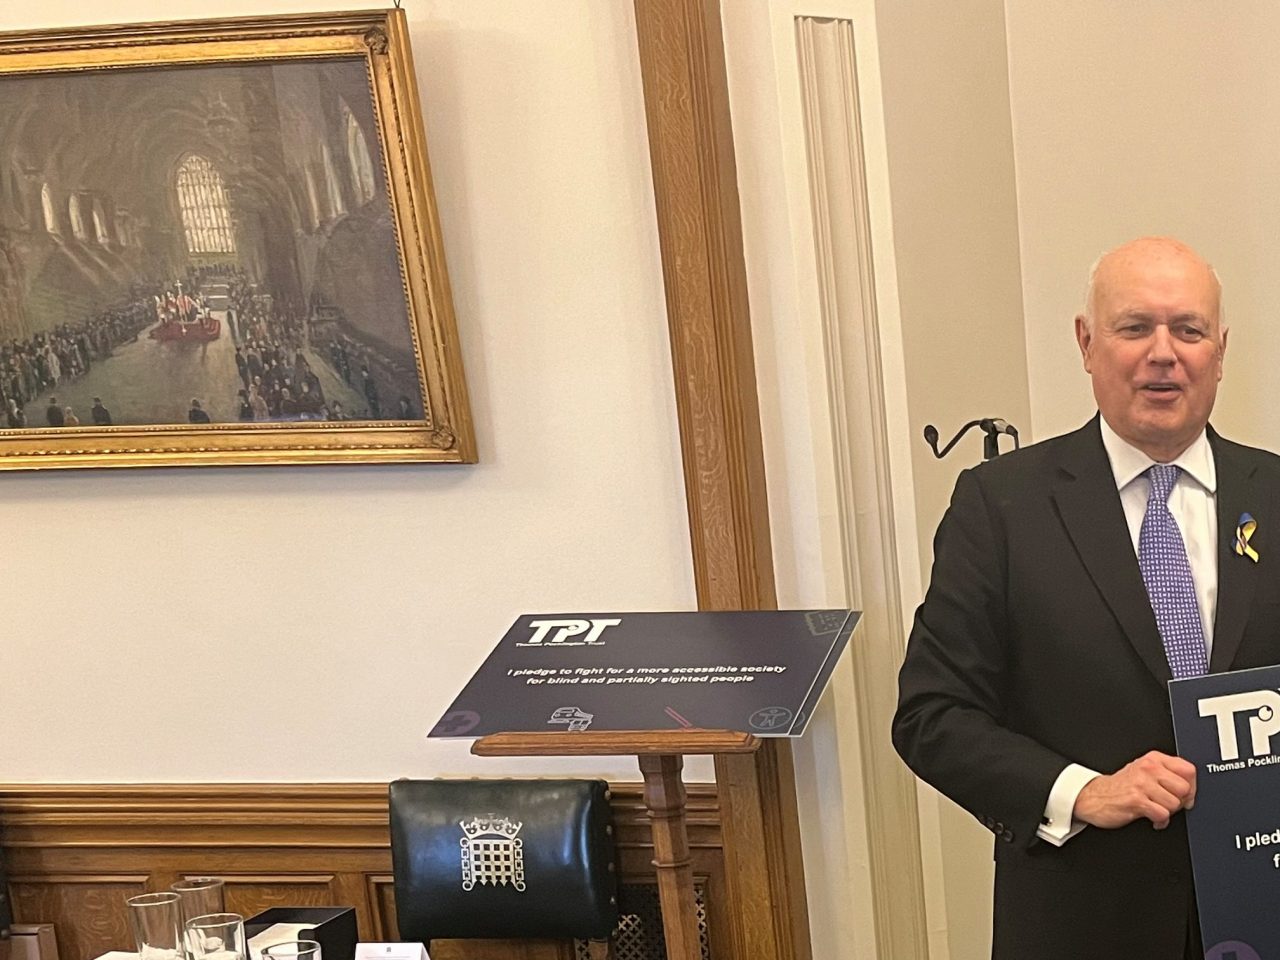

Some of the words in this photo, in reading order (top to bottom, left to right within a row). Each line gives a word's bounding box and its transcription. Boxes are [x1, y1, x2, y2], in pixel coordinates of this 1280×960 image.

[529, 619, 621, 643] TPT
[513, 668, 557, 677] pledge
[672, 666, 738, 674] accessible
[740, 666, 787, 674] society
[581, 676, 606, 684] and
[606, 676, 659, 685] partially
[660, 675, 709, 684] sighted
[709, 675, 755, 683] people
[1206, 760, 1246, 773] Thomas
[1235, 834, 1241, 849] I
